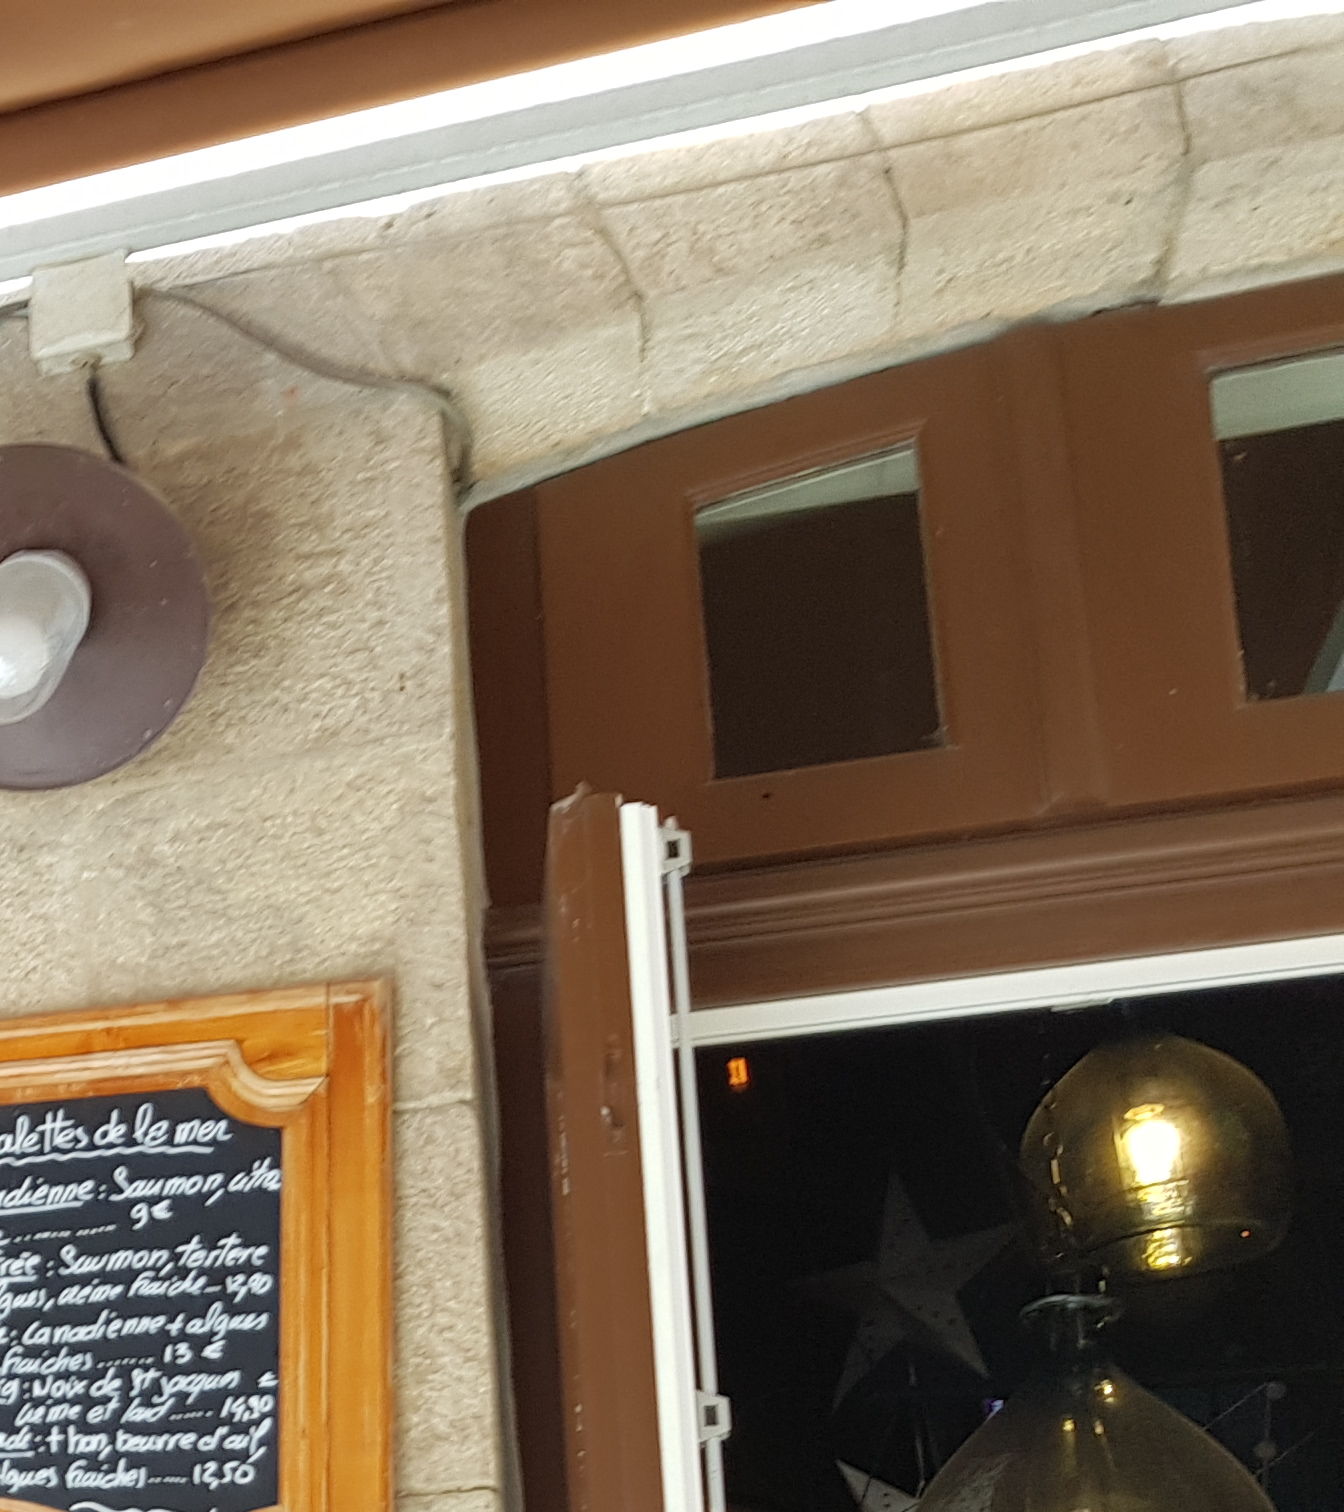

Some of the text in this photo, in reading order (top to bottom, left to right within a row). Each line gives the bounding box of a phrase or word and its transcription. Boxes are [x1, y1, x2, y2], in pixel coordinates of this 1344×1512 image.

[93, 1108, 127, 1146] de
[132, 1102, 170, 1147] la
[173, 1119, 234, 1145] mer
[175, 1232, 270, 1268] tartare
[185, 1301, 270, 1342] algues
[163, 1341, 193, 1364] 13
[89, 1367, 123, 1398] de
[85, 1397, 120, 1424] et
[120, 1396, 176, 1424] lard
[115, 1429, 198, 1452] beurre
[192, 1460, 256, 1491] 12,50
